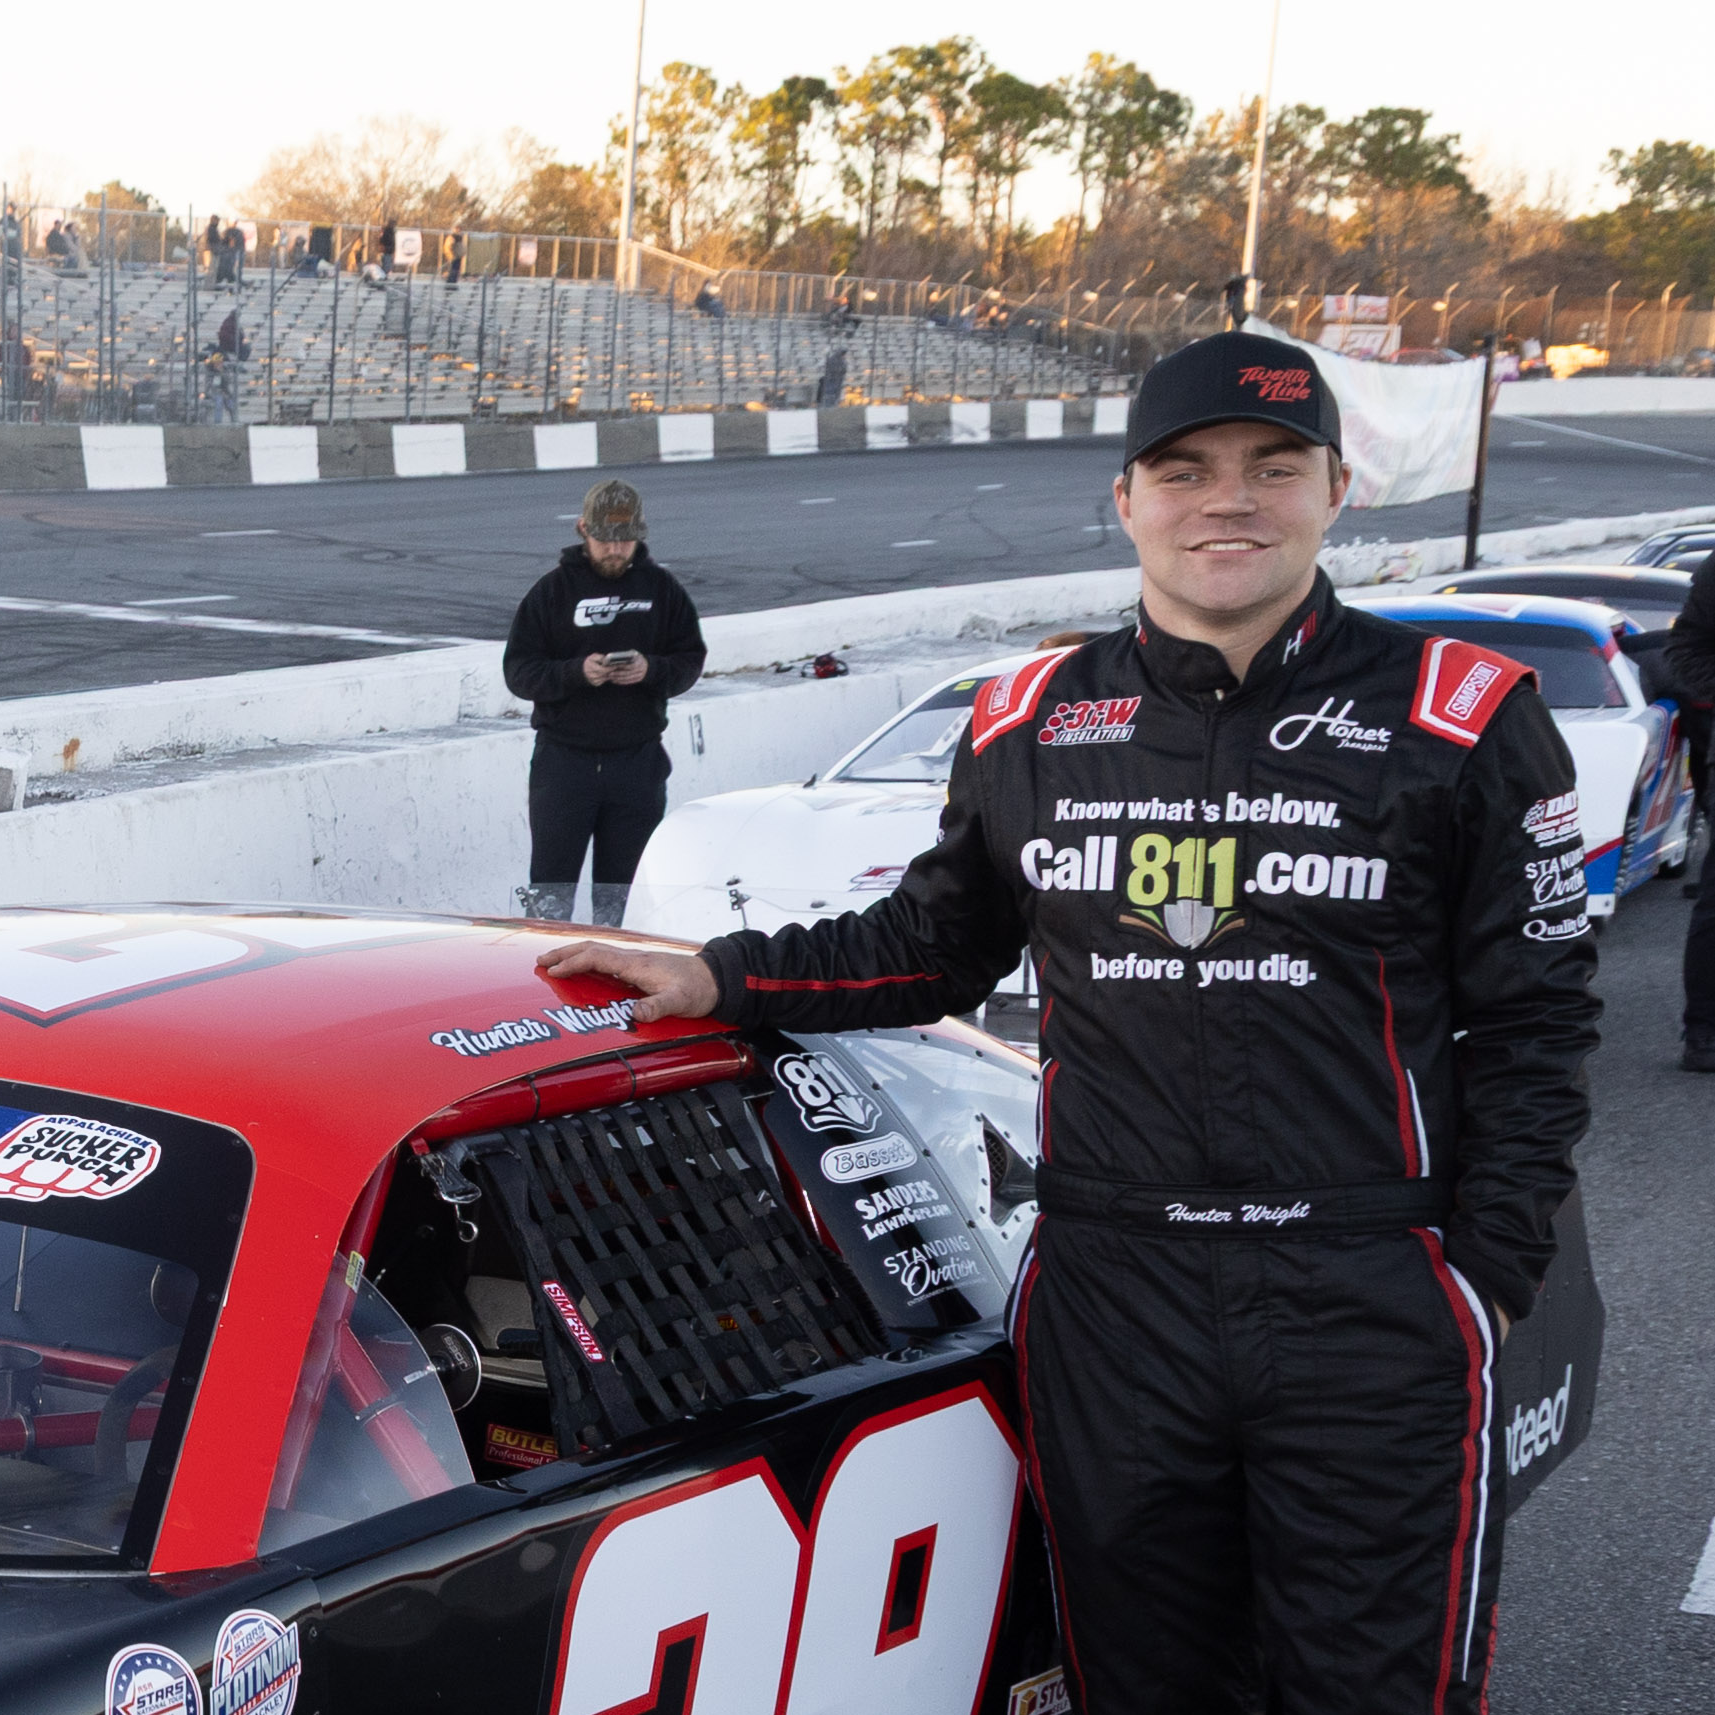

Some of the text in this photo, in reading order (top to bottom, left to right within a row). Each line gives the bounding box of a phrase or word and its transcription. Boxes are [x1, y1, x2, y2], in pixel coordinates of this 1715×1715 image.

[1451, 665, 1495, 716] SIMPSON
[688, 713, 705, 756] 13
[1058, 727, 1130, 743] INSULATION
[1055, 798, 1125, 822] Know
[1225, 791, 1341, 828] below.
[1020, 835, 1118, 891] Call
[1126, 832, 1237, 908] 811
[1090, 953, 1317, 987] before you dig.
[431, 998, 638, 1056] Hunter Wright
[784, 1057, 859, 1107] 811
[22, 1126, 146, 1172] SUCKER
[44, 1115, 152, 1148] APPALACHIAN
[3, 1144, 128, 1187] PUNCH
[834, 1140, 912, 1174] Bassett
[854, 1179, 939, 1221] SANDERS
[1165, 1200, 1311, 1227] Hunter Wright
[861, 1203, 952, 1241] LawnCare.com
[883, 1234, 971, 1275] STANDING
[900, 1256, 980, 1297] Ovation
[544, 1281, 604, 1361] SIMPSON
[488, 1447, 543, 1465] Professional
[491, 1427, 558, 1454] BUTLE
[234, 1621, 265, 1653] STARS
[136, 1681, 184, 1709] STARS
[136, 1700, 166, 1715] NATIONAL
